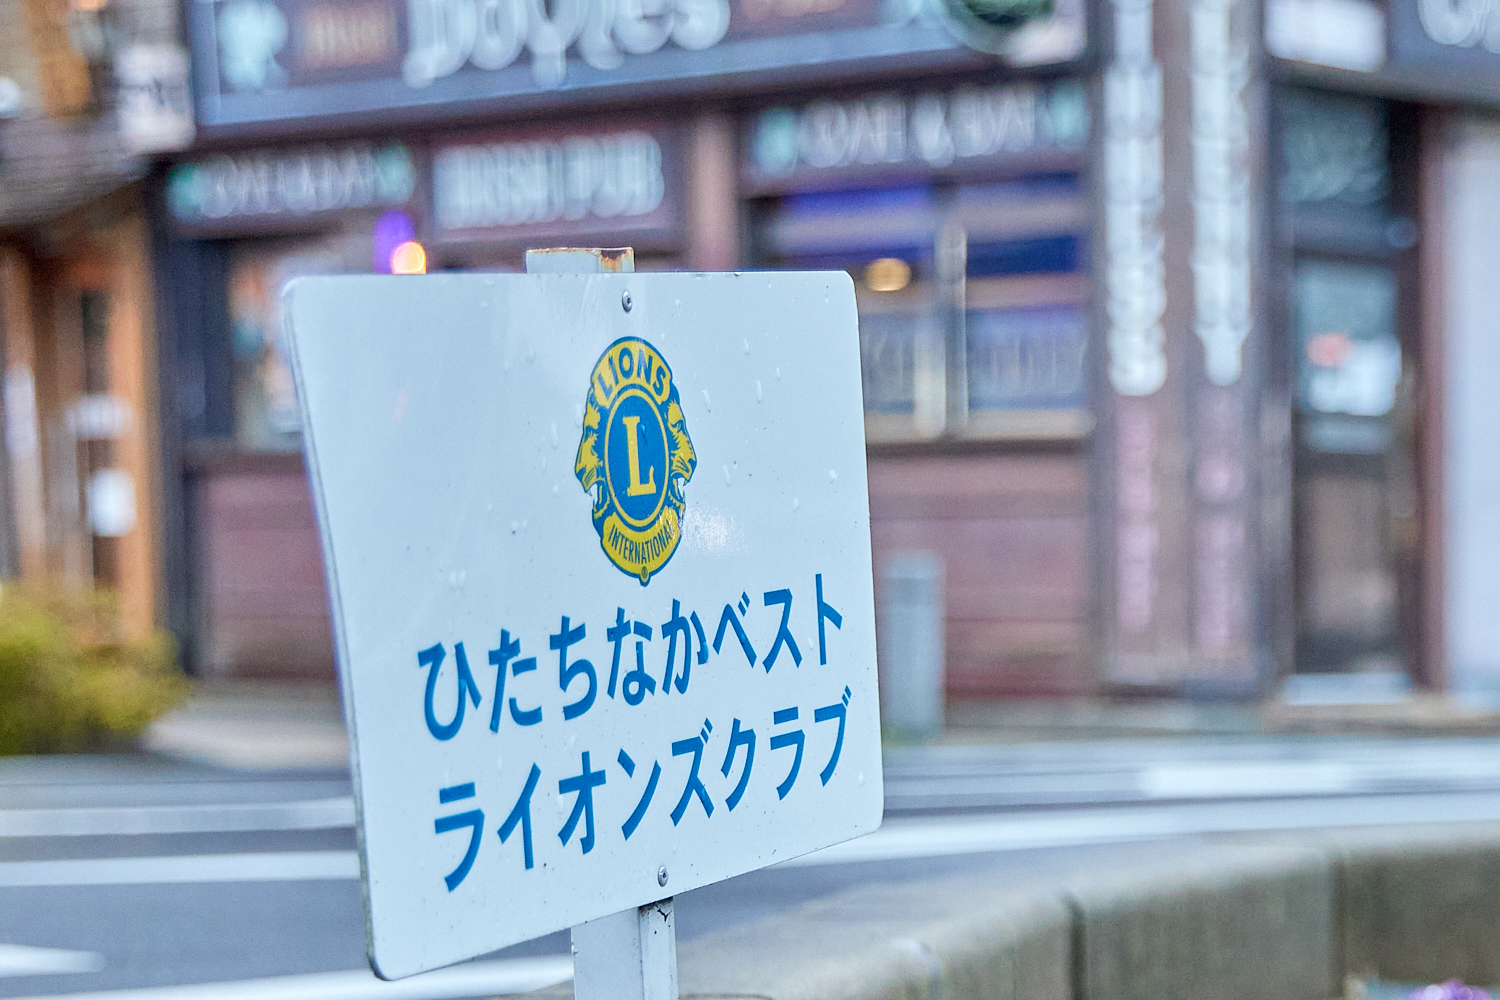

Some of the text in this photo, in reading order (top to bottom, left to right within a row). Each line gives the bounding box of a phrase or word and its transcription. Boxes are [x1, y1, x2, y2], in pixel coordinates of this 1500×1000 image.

[597, 347, 667, 402] LIONS
[622, 415, 657, 497] L
[607, 519, 676, 565] INTERNATIONAL
[418, 573, 843, 741] ひたちなかベスト
[434, 685, 852, 892] ライオンズクラブ
